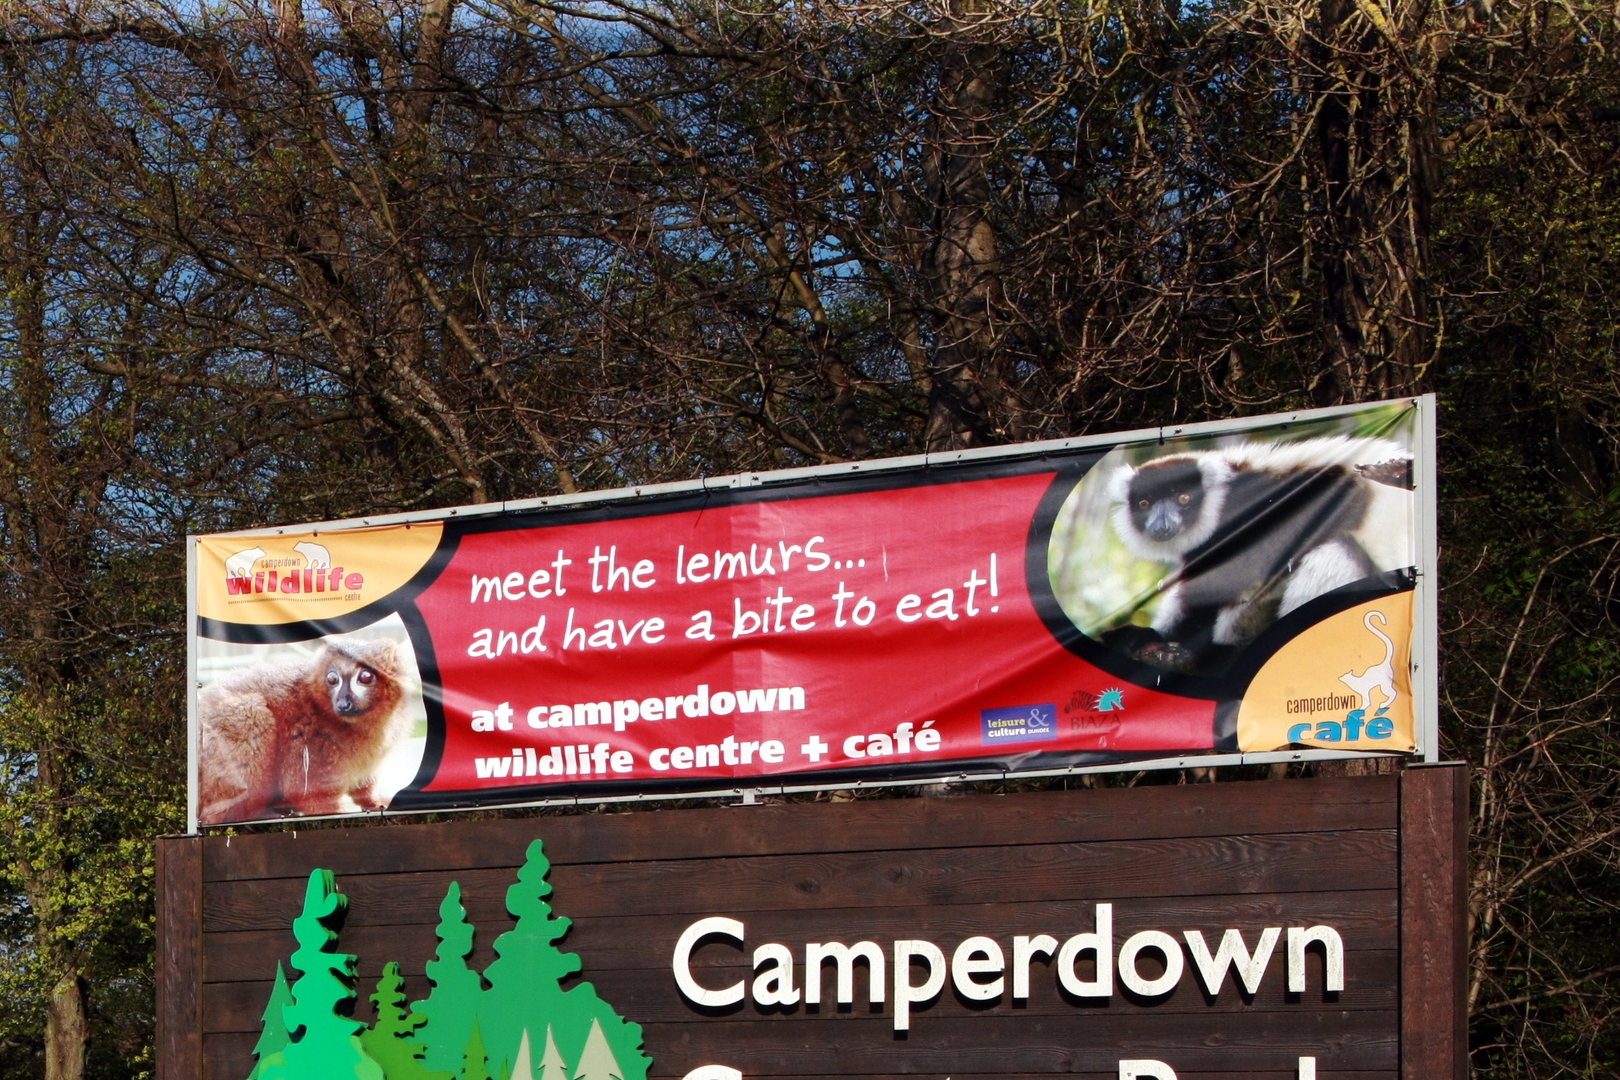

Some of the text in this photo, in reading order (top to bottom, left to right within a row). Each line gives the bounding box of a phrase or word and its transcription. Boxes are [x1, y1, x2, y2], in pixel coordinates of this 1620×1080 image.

[261, 557, 301, 569] camperdown
[470, 536, 865, 603] meet the lemurs...
[226, 567, 364, 595] wildlife
[344, 592, 361, 602] centre
[467, 553, 999, 659] and have a bite to eat!
[471, 684, 806, 732] at camperdown
[1286, 692, 1356, 715] camperdown
[987, 708, 1050, 729] leisure &
[987, 727, 1050, 738] culture DUNDEE
[1070, 714, 1122, 731] BIAZA
[1287, 707, 1394, 743] café
[474, 721, 942, 778] wildlife centre + café
[672, 903, 1345, 1031] Camperdown
